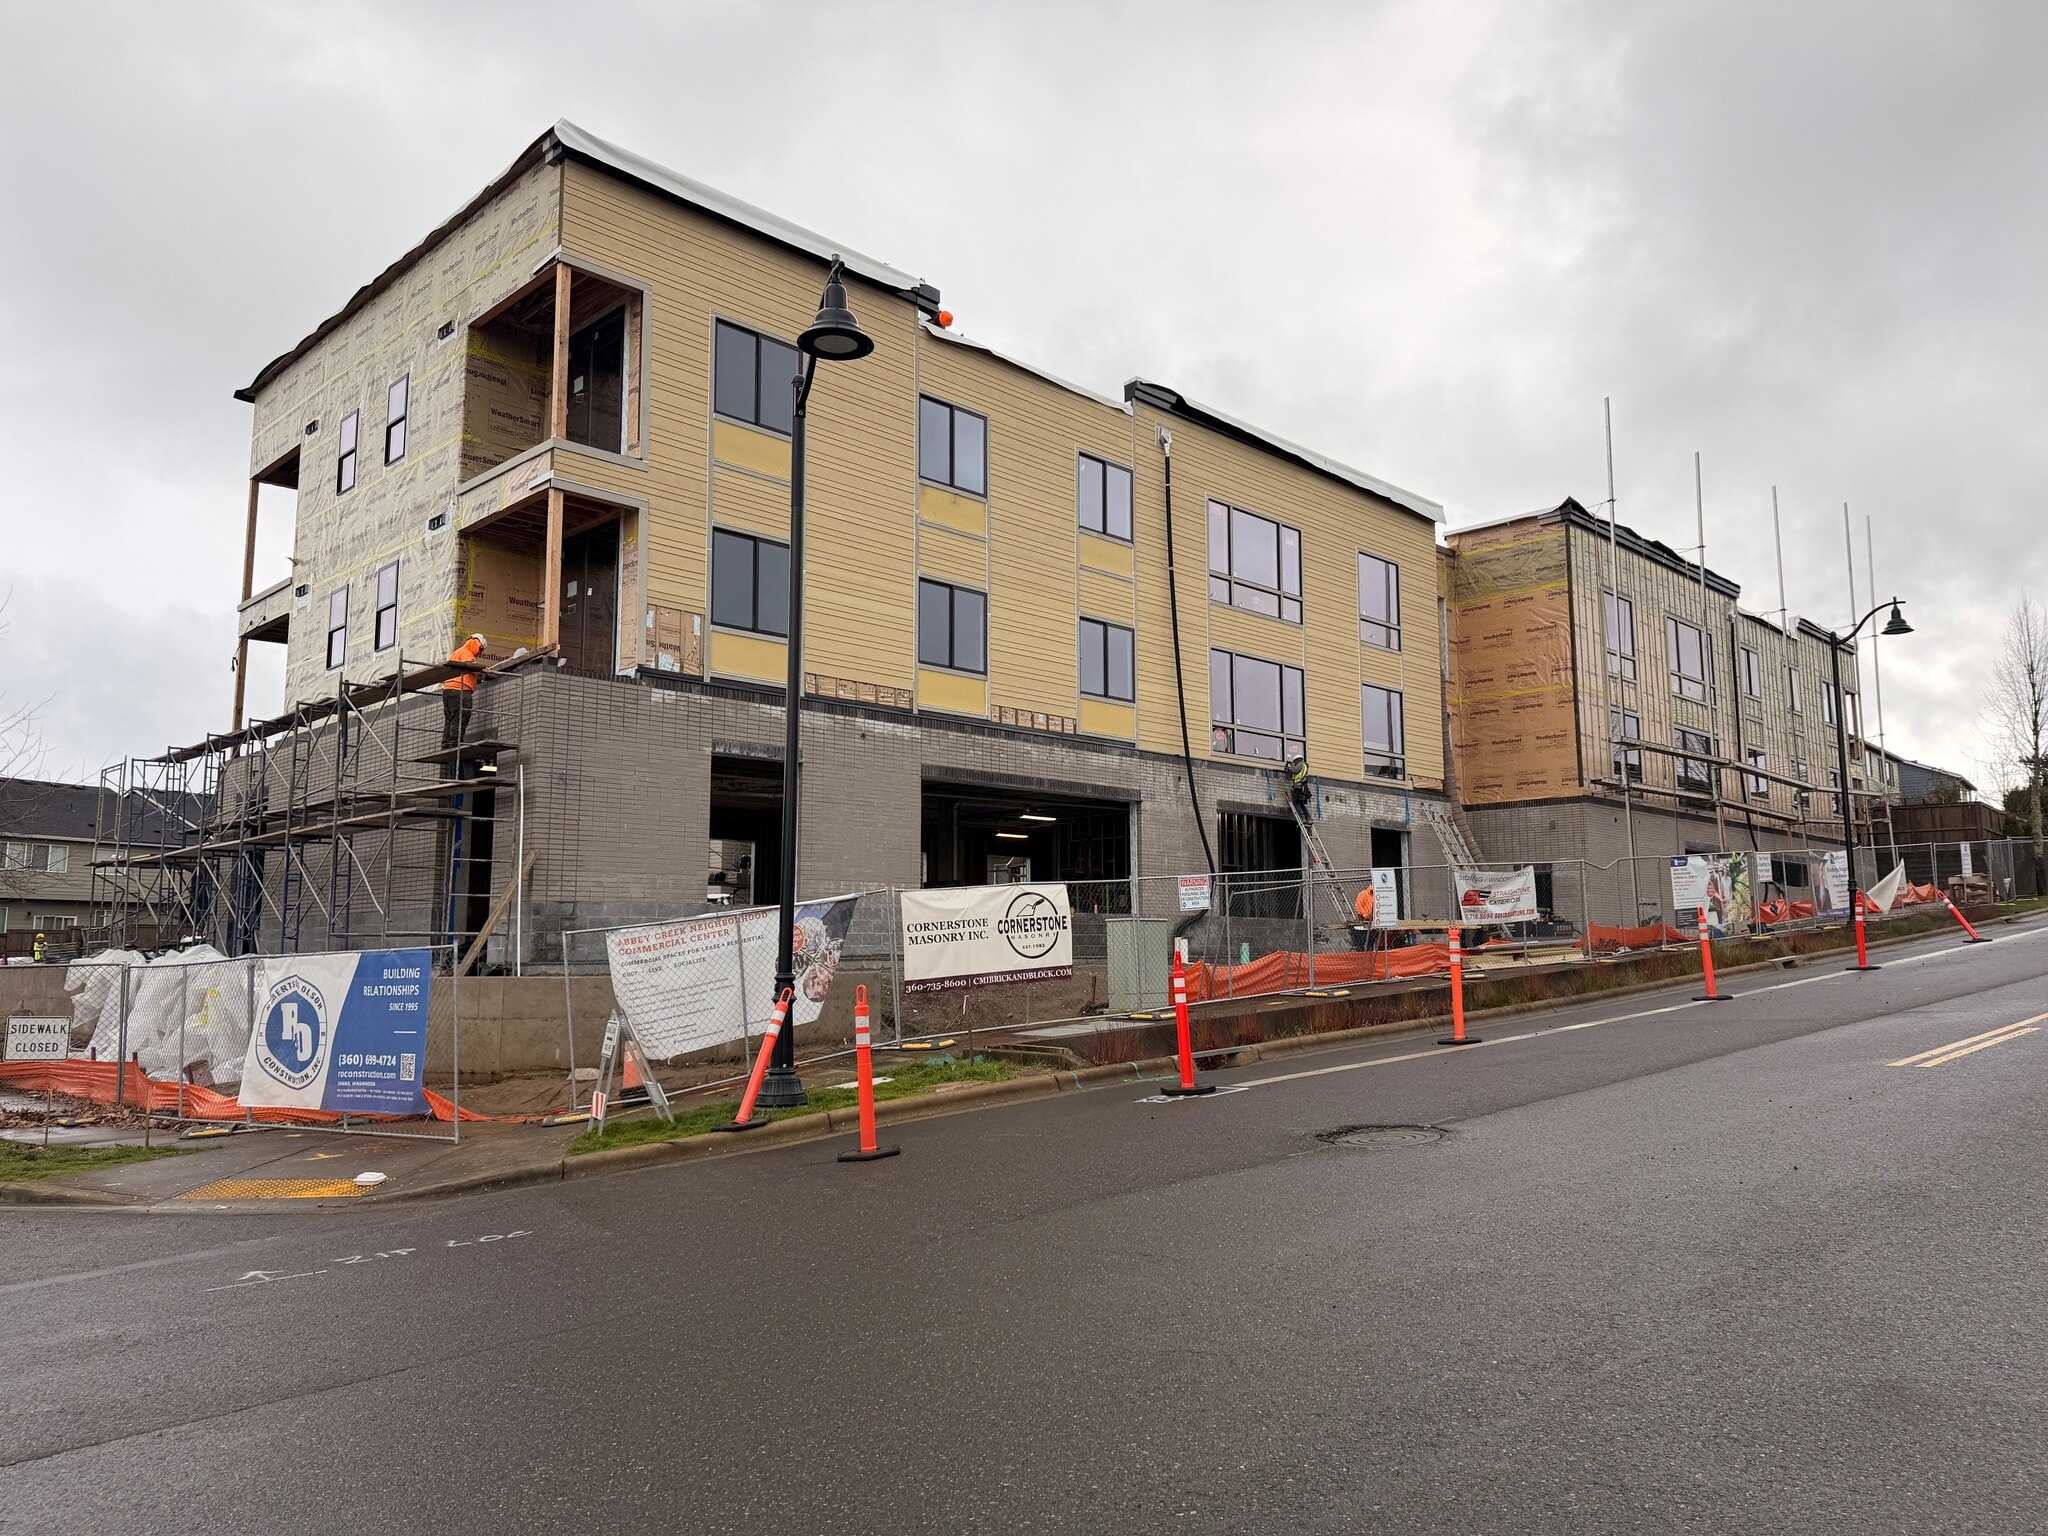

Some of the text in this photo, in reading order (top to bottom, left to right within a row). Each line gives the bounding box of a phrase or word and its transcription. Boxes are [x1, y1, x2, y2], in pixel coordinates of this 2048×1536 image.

[490, 407, 541, 428] WeatherSmart
[907, 918, 989, 933] CORNERSTONE
[997, 915, 1068, 935] CORNERSTONE
[618, 934, 651, 947] ABBEY
[654, 926, 687, 940] CREEK
[618, 929, 730, 956] COMMERCIAL CENTER
[726, 934, 766, 948] RESDENTIAL
[908, 930, 989, 945] MASONRY INC.
[1011, 932, 1057, 940] MASONRY
[383, 967, 420, 979] BUILDING
[905, 968, 1072, 994] 360-735-8600 CMIBRICKANDBLOCK.COM
[363, 985, 420, 997] RELATIONSHIPS
[301, 986, 323, 1011] OLSON
[388, 1002, 404, 1012] SINCE
[11, 1024, 66, 1034] SIDEWALK
[15, 1042, 59, 1053] CLOSED
[338, 1053, 397, 1066] (360) 699-4724
